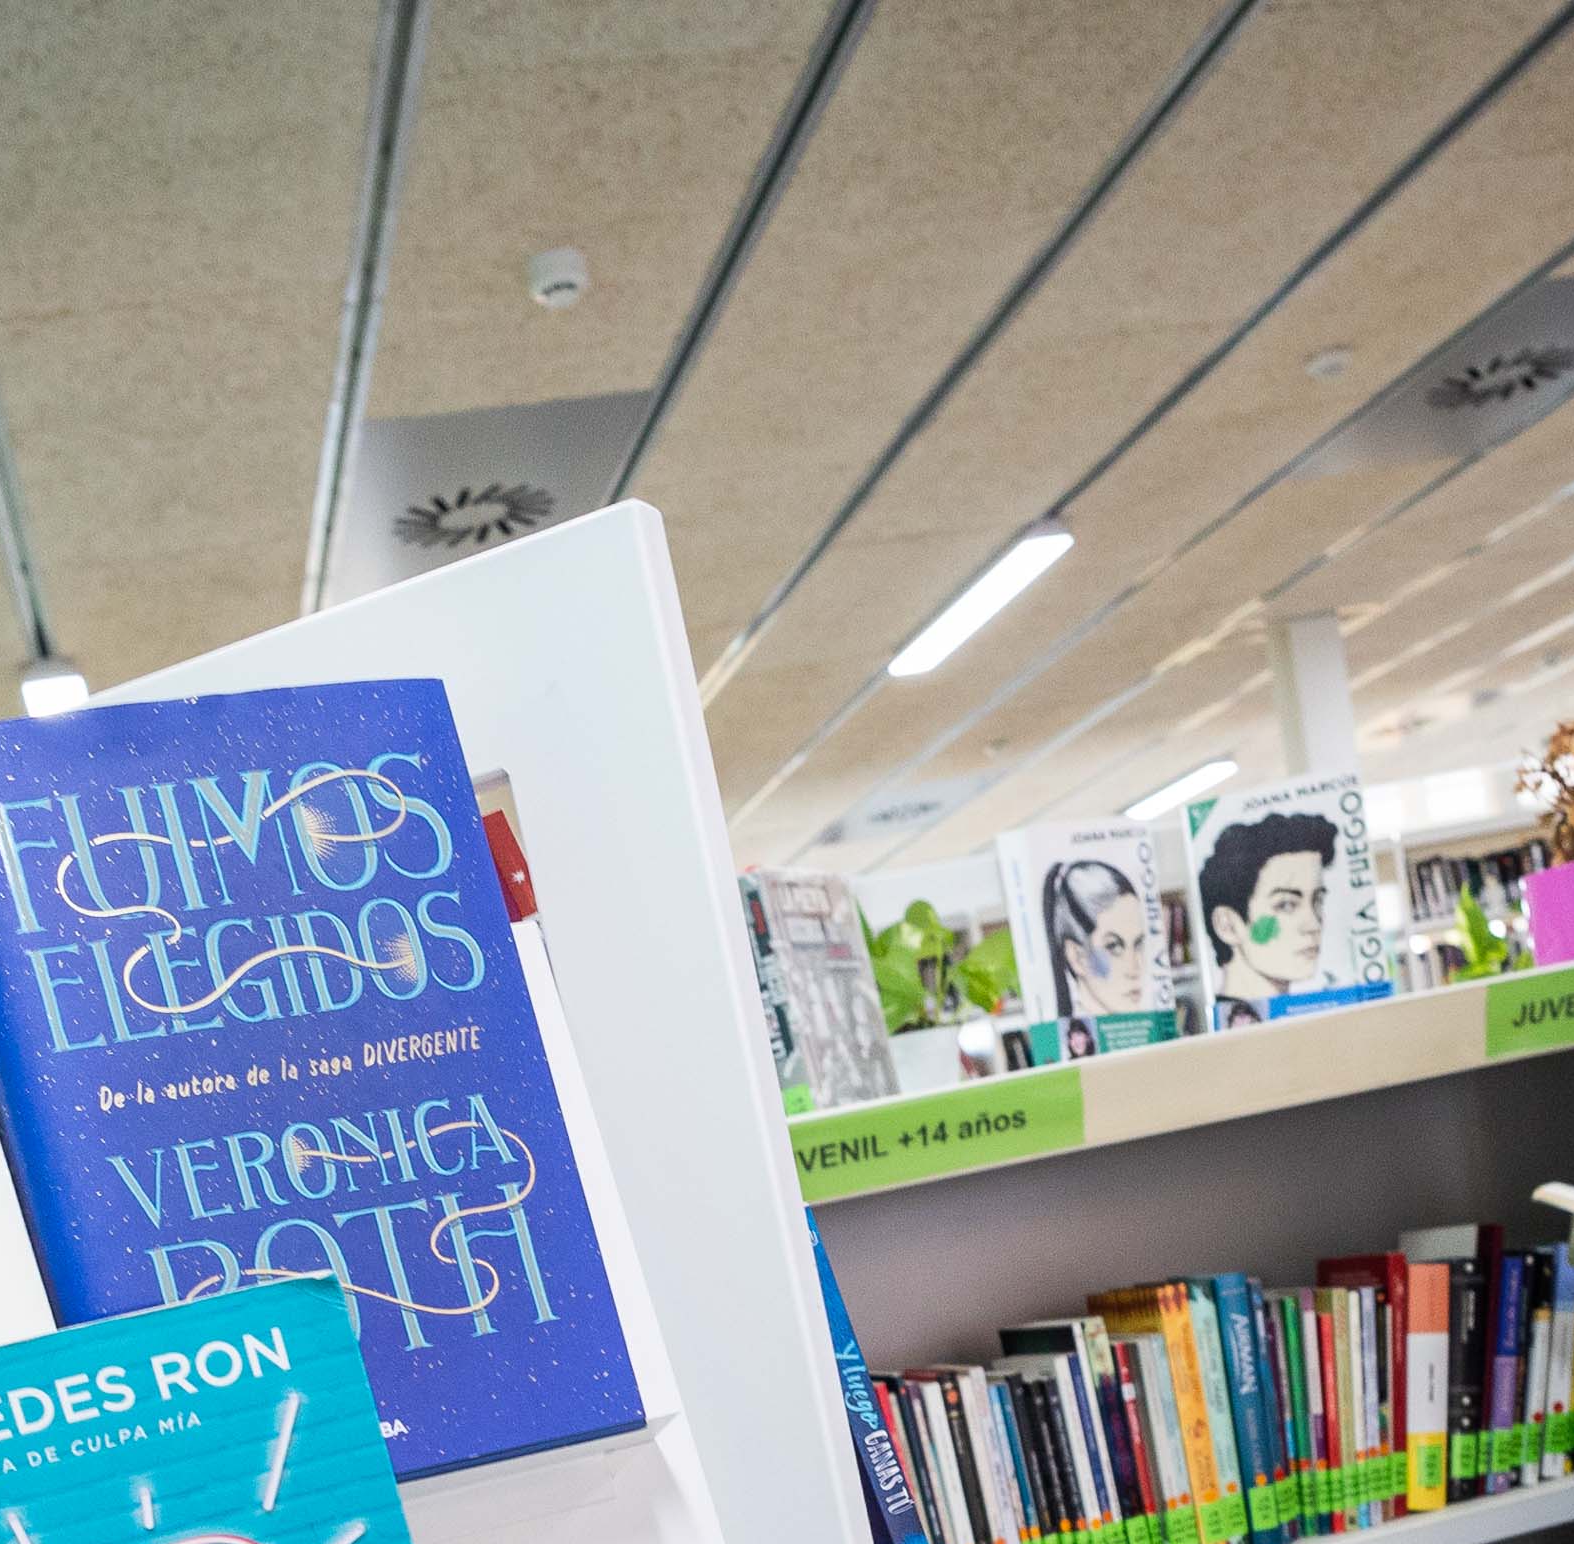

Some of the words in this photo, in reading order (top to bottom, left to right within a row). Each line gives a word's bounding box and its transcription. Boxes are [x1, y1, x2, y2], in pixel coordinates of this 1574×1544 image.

[26, 889, 486, 1054] ELEGIDOS
[98, 1082, 132, 1112] De
[135, 1079, 157, 1106] la
[167, 1067, 236, 1101] autora
[246, 1061, 271, 1087] de
[280, 1055, 299, 1083] la
[309, 1052, 354, 1082] saga
[362, 1025, 482, 1068] DIVERGENTE
[107, 1093, 515, 1227] VERONICA
[795, 1130, 889, 1176] VENIL
[898, 1111, 948, 1149] +14
[957, 1107, 1027, 1142] años
[150, 1325, 292, 1399] RON
[26, 1445, 61, 1469] DE
[69, 1424, 150, 1462] CULPA
[158, 1410, 203, 1438] MÍA
[841, 1364, 881, 1432] luego
[864, 1428, 906, 1491] GANAS
